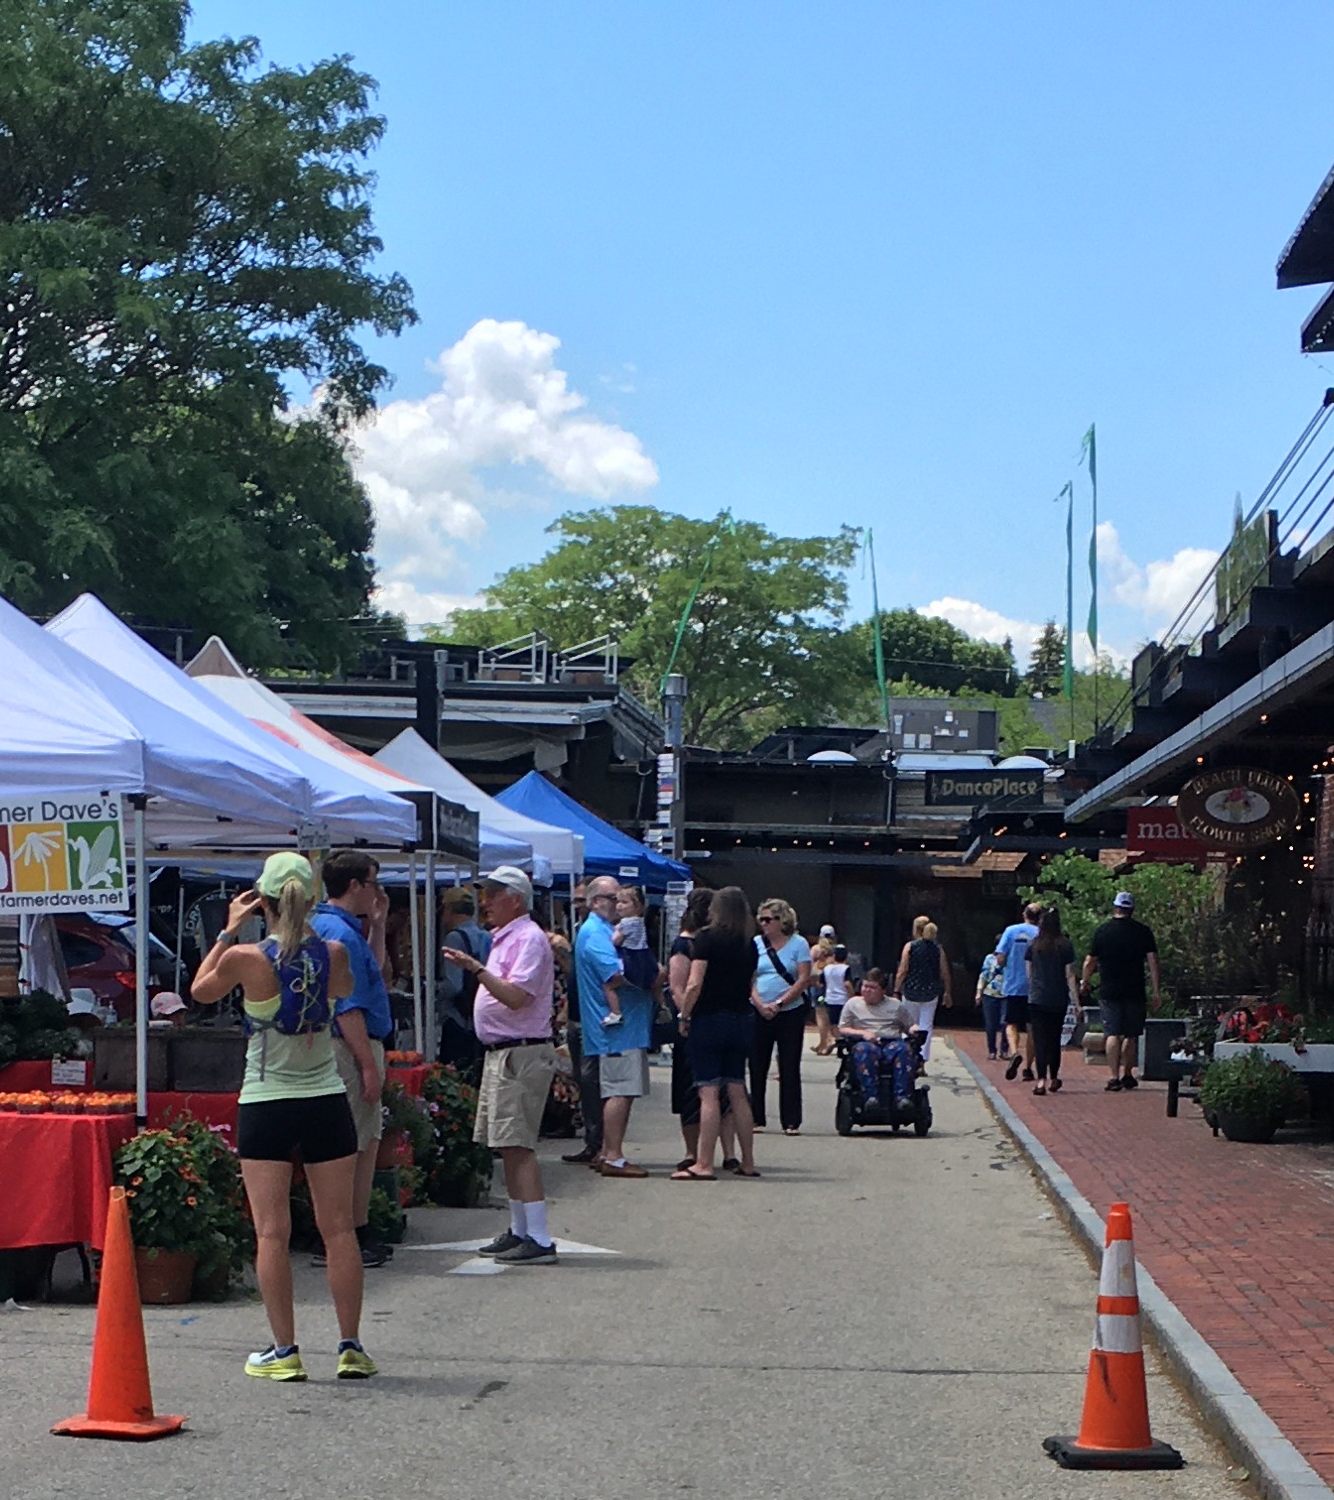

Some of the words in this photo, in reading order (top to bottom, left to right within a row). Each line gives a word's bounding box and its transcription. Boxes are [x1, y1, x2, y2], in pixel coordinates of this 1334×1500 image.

[941, 778, 1038, 796] DancePlace
[1192, 769, 1241, 795] BEACH
[41, 799, 119, 821] Dave's
[1189, 815, 1246, 843] FLOWER
